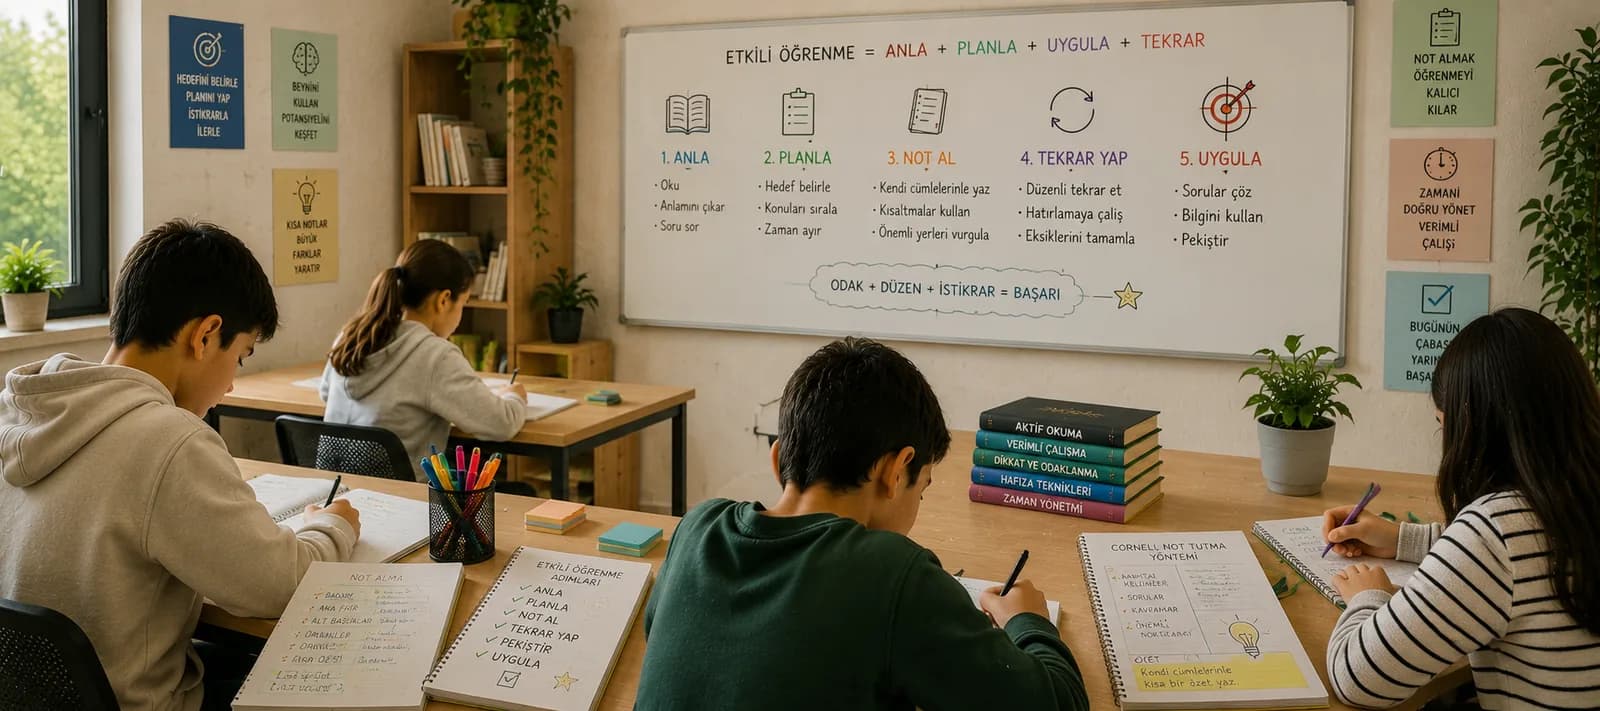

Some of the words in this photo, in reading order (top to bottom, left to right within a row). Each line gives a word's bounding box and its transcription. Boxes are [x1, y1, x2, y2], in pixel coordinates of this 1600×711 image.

[726, 46, 771, 64] ETKİLİ
[779, 45, 855, 62] ÖĞRENME
[885, 41, 928, 58] ANLA
[957, 40, 1017, 55] PLANLA
[1047, 36, 1110, 52] UYGULA
[1141, 32, 1205, 49] TEKRAR
[1414, 53, 1436, 64] NOT
[1439, 53, 1475, 64] ALMAK
[186, 91, 215, 102] PLANINI
[216, 93, 231, 103] YAP
[1427, 88, 1459, 98] KALICI
[293, 98, 318, 108] KULLAN
[1428, 105, 1457, 115] KILAR
[661, 151, 670, 164] 1.
[673, 151, 710, 164] ANLA
[764, 151, 775, 164] 2.
[779, 151, 832, 165] PLANLA
[888, 151, 899, 165] 3.
[903, 151, 932, 165] NOT
[937, 151, 956, 165] AL
[1020, 151, 1033, 166] 4.
[1038, 151, 1094, 166] TEKRAR
[1100, 151, 1128, 166] YAP
[1180, 152, 1193, 166] 5.
[1199, 151, 1262, 166] UYGULA
[660, 179, 680, 191] Oku
[765, 180, 796, 192] Hedef
[799, 181, 831, 193] belirle
[880, 181, 907, 193] Kendi
[910, 182, 969, 194] cümlelerinle
[972, 185, 990, 198] yaz
[1026, 182, 1067, 196] Düzenli
[1071, 183, 1106, 196] tekrar
[1109, 184, 1122, 196] et
[1182, 184, 1227, 198] Sorular
[1231, 186, 1252, 201] çöz
[702, 201, 725, 215] çıkar
[765, 202, 805, 214] Konuları
[810, 203, 838, 215] sırala
[879, 204, 936, 216] Kısaltmalar
[940, 204, 970, 217] kullan
[1026, 206, 1093, 223] Hatırlamaya
[1404, 202, 1439, 214] DOĞRU
[1442, 202, 1476, 215] YÖNET
[286, 220, 301, 229] KISA
[303, 219, 328, 229] NOTLAR
[1182, 208, 1220, 226] Bilgini
[1225, 209, 1263, 223] kullan
[660, 220, 682, 232] Soru
[685, 223, 700, 232] sor
[765, 223, 798, 235] Zaman
[802, 227, 822, 239] ayır
[1419, 220, 1459, 232] VERİMLİ
[297, 233, 317, 244] BÜYÜK
[879, 224, 913, 239] Önemli
[916, 227, 948, 243] yerleri
[951, 228, 989, 244] vurgula
[1025, 229, 1082, 243] Eksiklerini
[1086, 231, 1135, 245] tamamla
[1181, 233, 1229, 250] Pekiştir
[830, 279, 864, 292] ODAK
[881, 279, 922, 294] DÜZEN
[939, 280, 995, 297] İSTİKRAR
[1014, 286, 1060, 302] BAŞARI
[1410, 320, 1460, 333] BUGÜNÜN
[1406, 371, 1434, 384] BAŞA
[1016, 421, 1044, 434] AKTİF
[1046, 426, 1082, 440] OKUMA
[1007, 439, 1043, 452] VERİMLİ
[994, 455, 1025, 468] DİKKAT
[1041, 462, 1098, 479] ODAKLANMA
[1000, 475, 1034, 488] HAFIZA
[1036, 479, 1092, 497] TEKNİKLERİ
[1003, 493, 1037, 507] ZAMAN
[1111, 543, 1160, 552] CORNELL
[1163, 543, 1184, 551] NOT
[1188, 543, 1227, 551] TUTMA
[537, 560, 569, 572] ETKİLİ
[572, 564, 623, 579] ÖĞRENME
[534, 586, 563, 597] ANLA
[526, 598, 569, 612] PLANLA
[518, 611, 543, 622] NOT
[544, 616, 559, 625] AL
[510, 624, 554, 638] TEKRAR
[558, 632, 579, 642] YAP
[500, 637, 552, 654] PEKİŞTİR
[492, 652, 541, 669] UYGULA
